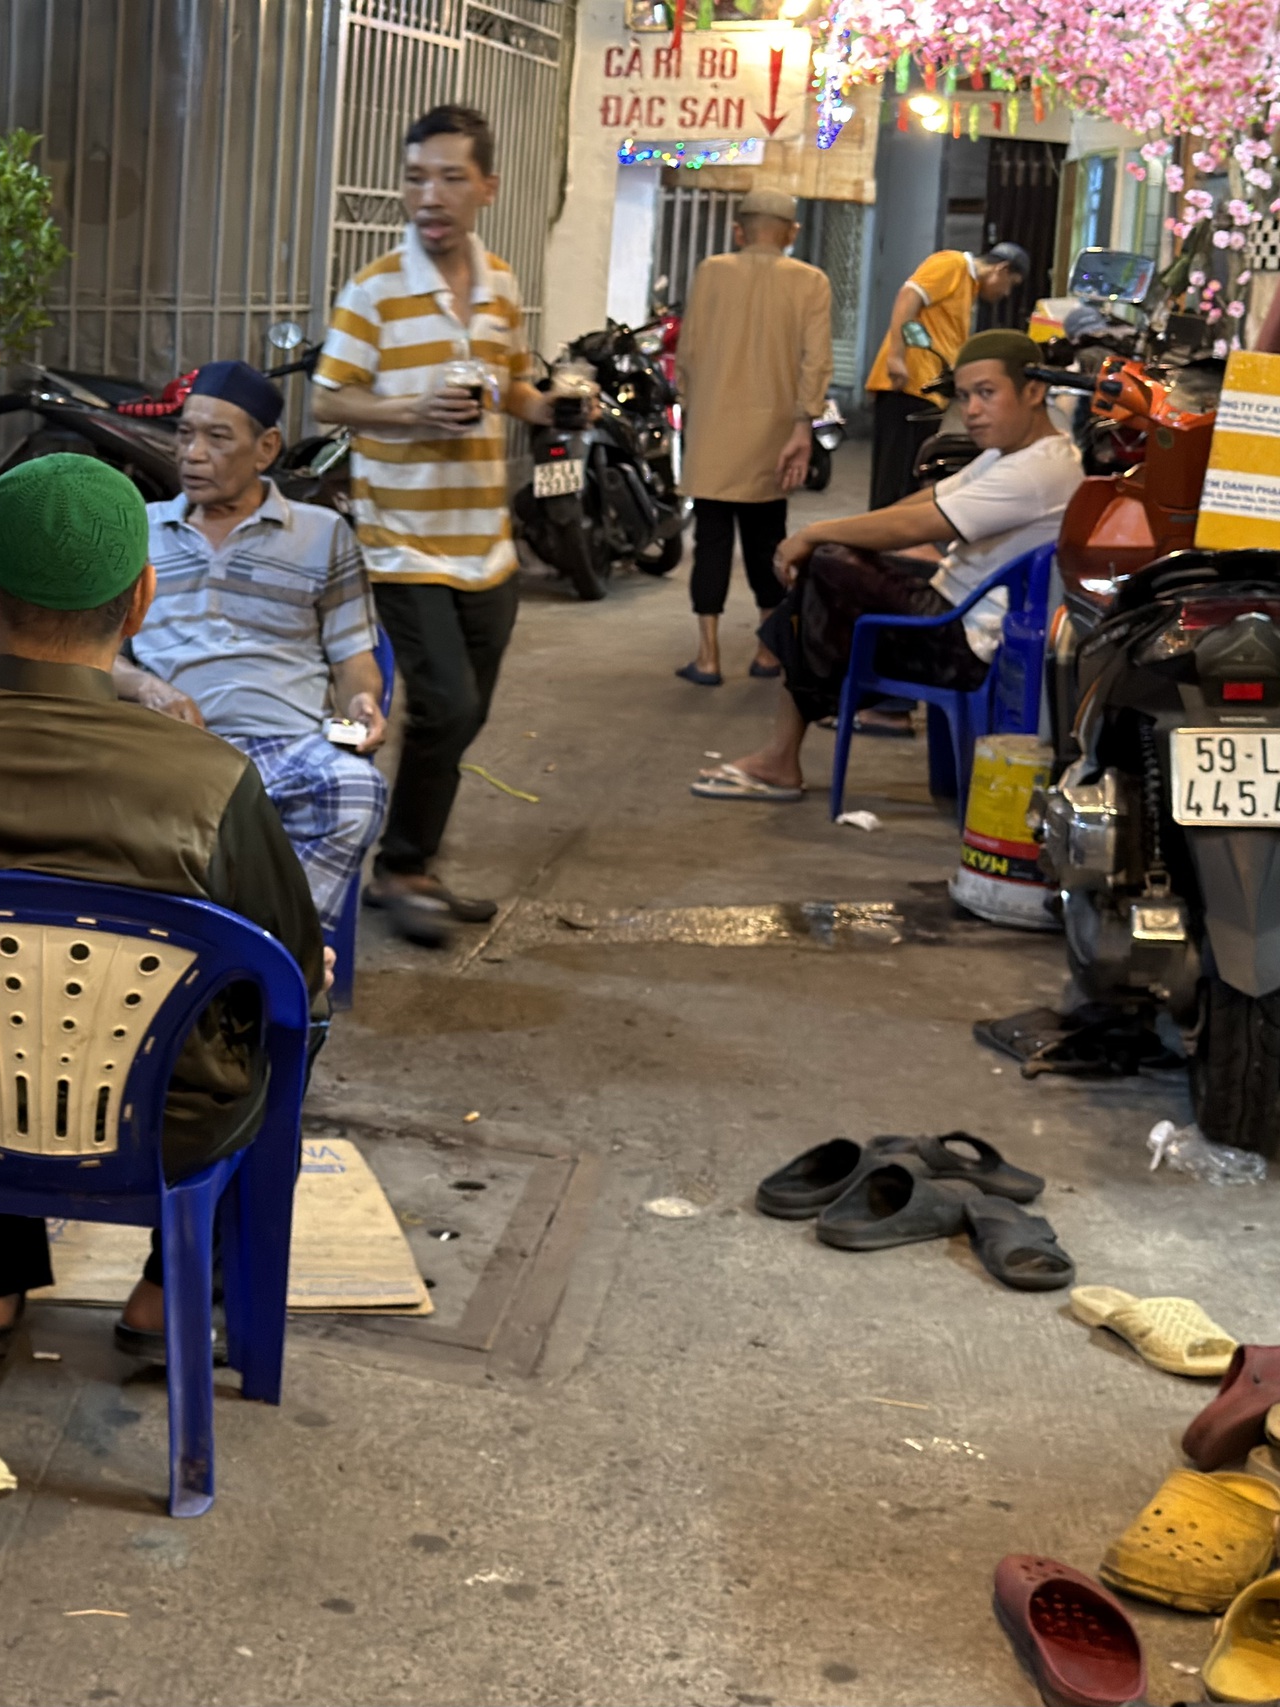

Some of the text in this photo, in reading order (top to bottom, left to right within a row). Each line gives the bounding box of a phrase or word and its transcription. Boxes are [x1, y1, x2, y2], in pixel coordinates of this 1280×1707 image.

[604, 37, 738, 80] CÀ RI BÒ
[600, 83, 745, 136] ĐẶC SẢN
[1196, 737, 1280, 774] 59-L
